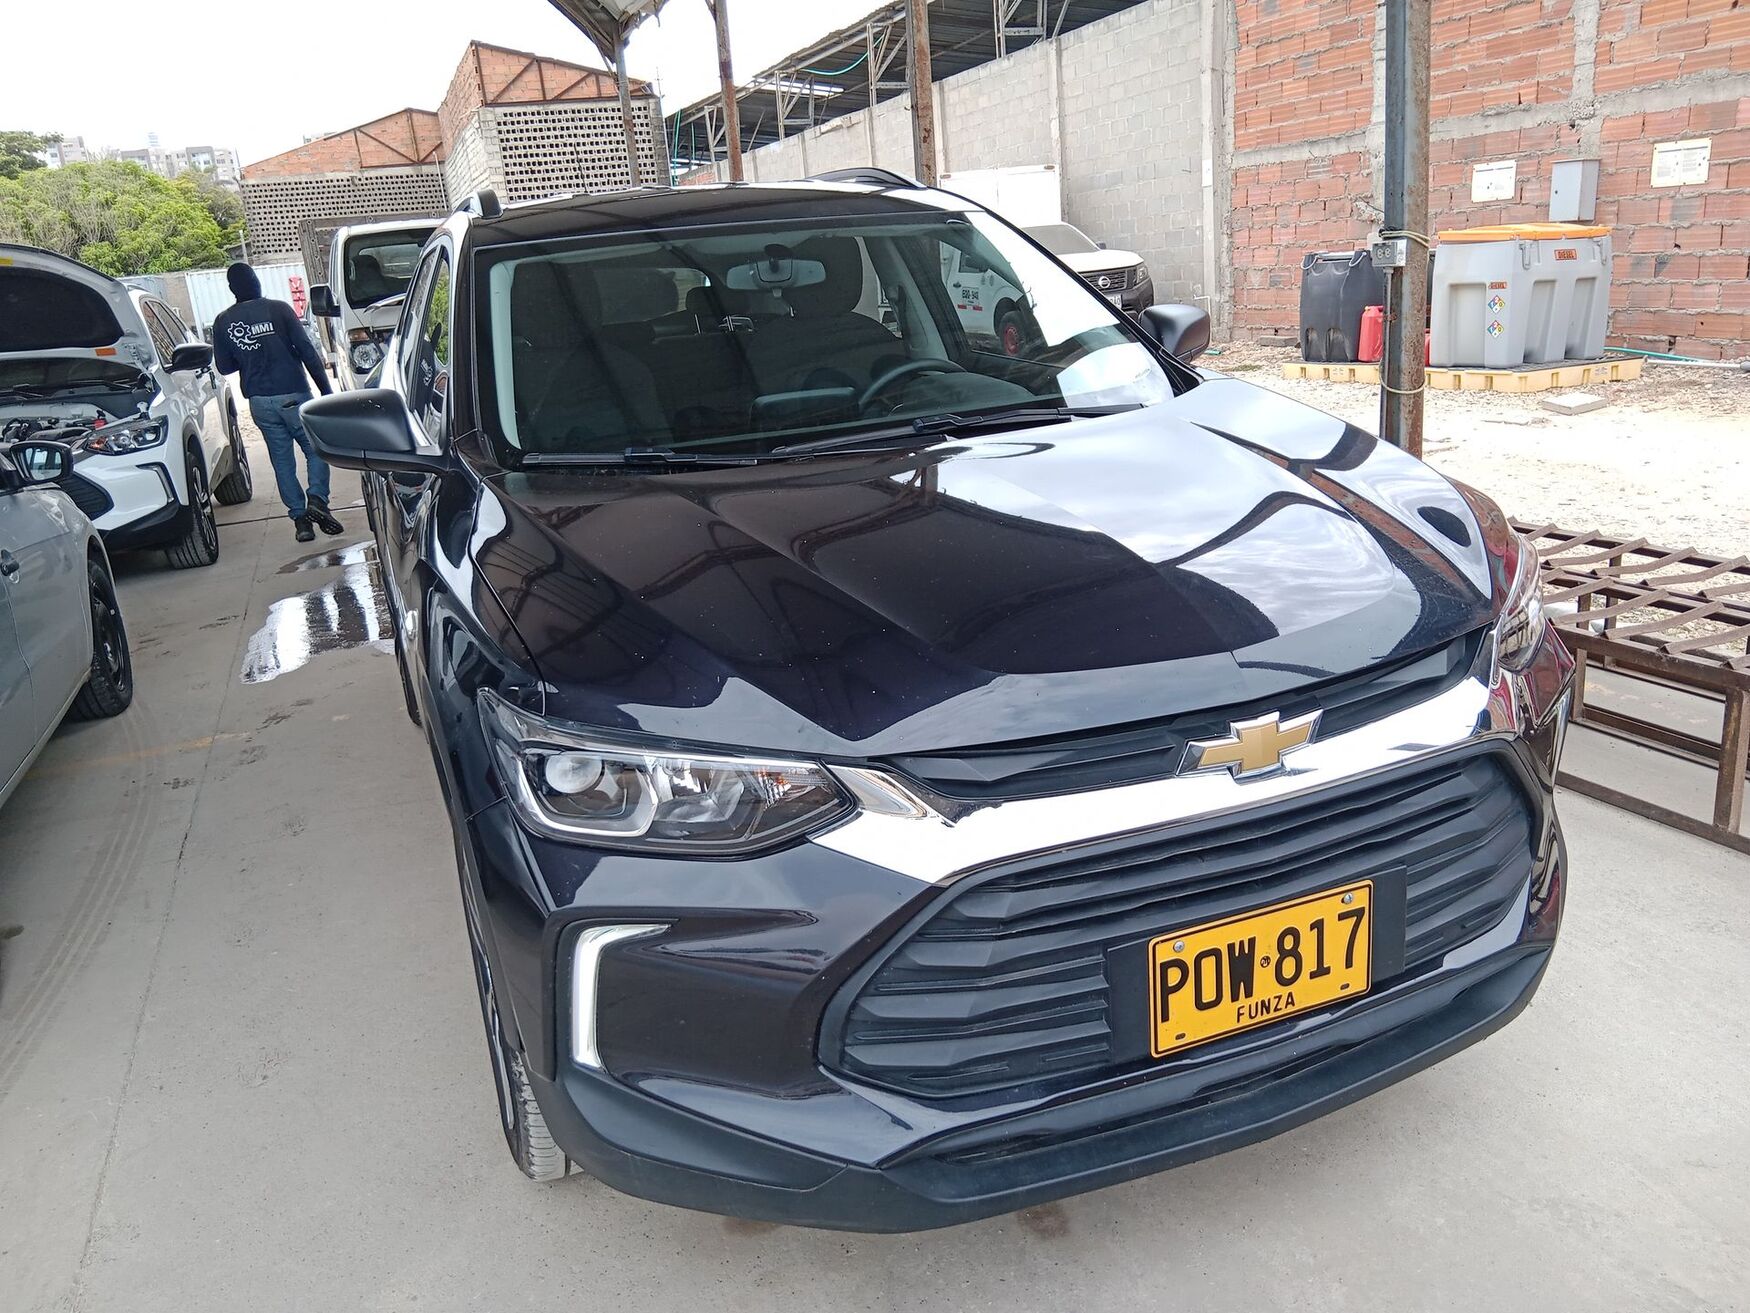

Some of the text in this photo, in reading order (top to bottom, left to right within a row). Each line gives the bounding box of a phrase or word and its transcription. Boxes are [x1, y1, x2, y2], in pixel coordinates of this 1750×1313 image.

[1159, 906, 1366, 1023] POW 817
[1236, 991, 1296, 1023] FUNZA
